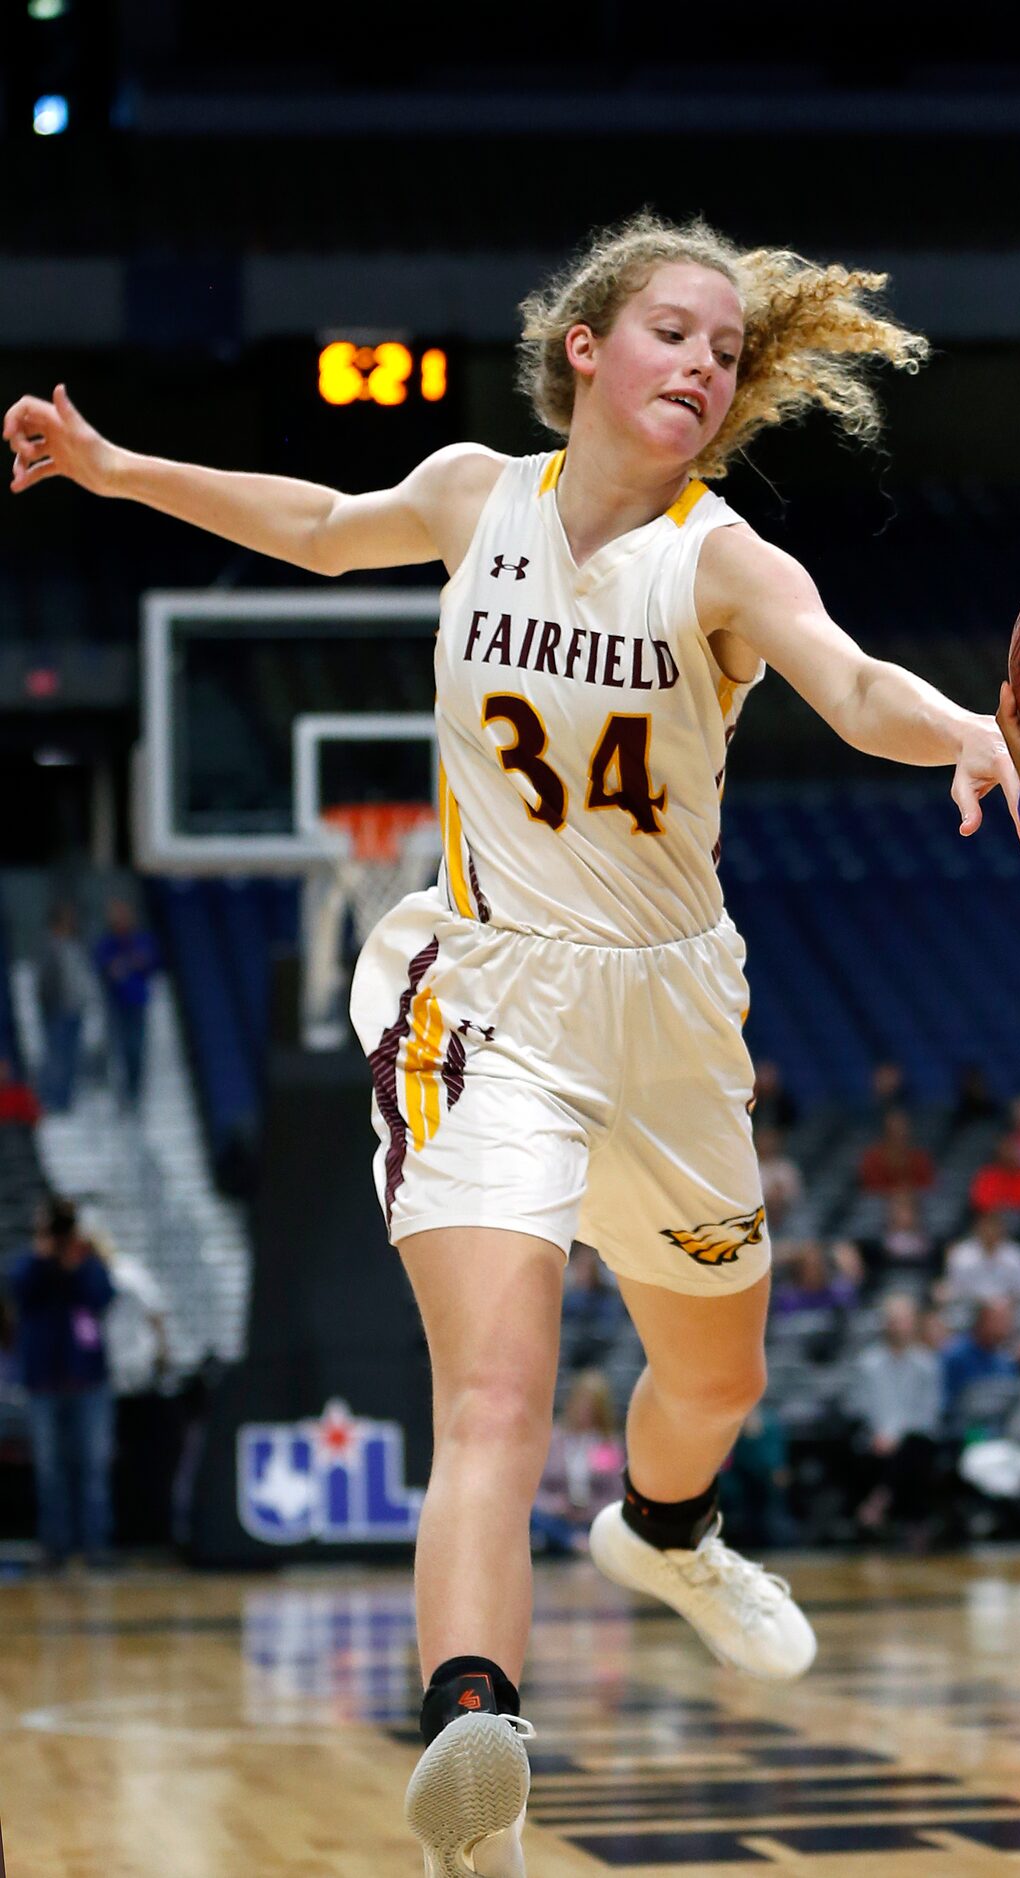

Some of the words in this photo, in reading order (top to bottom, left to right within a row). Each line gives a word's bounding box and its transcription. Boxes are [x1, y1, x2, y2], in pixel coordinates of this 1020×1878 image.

[319, 341, 447, 405] 6:21
[463, 611, 680, 689] FAIRFIELD
[481, 691, 668, 836] 34
